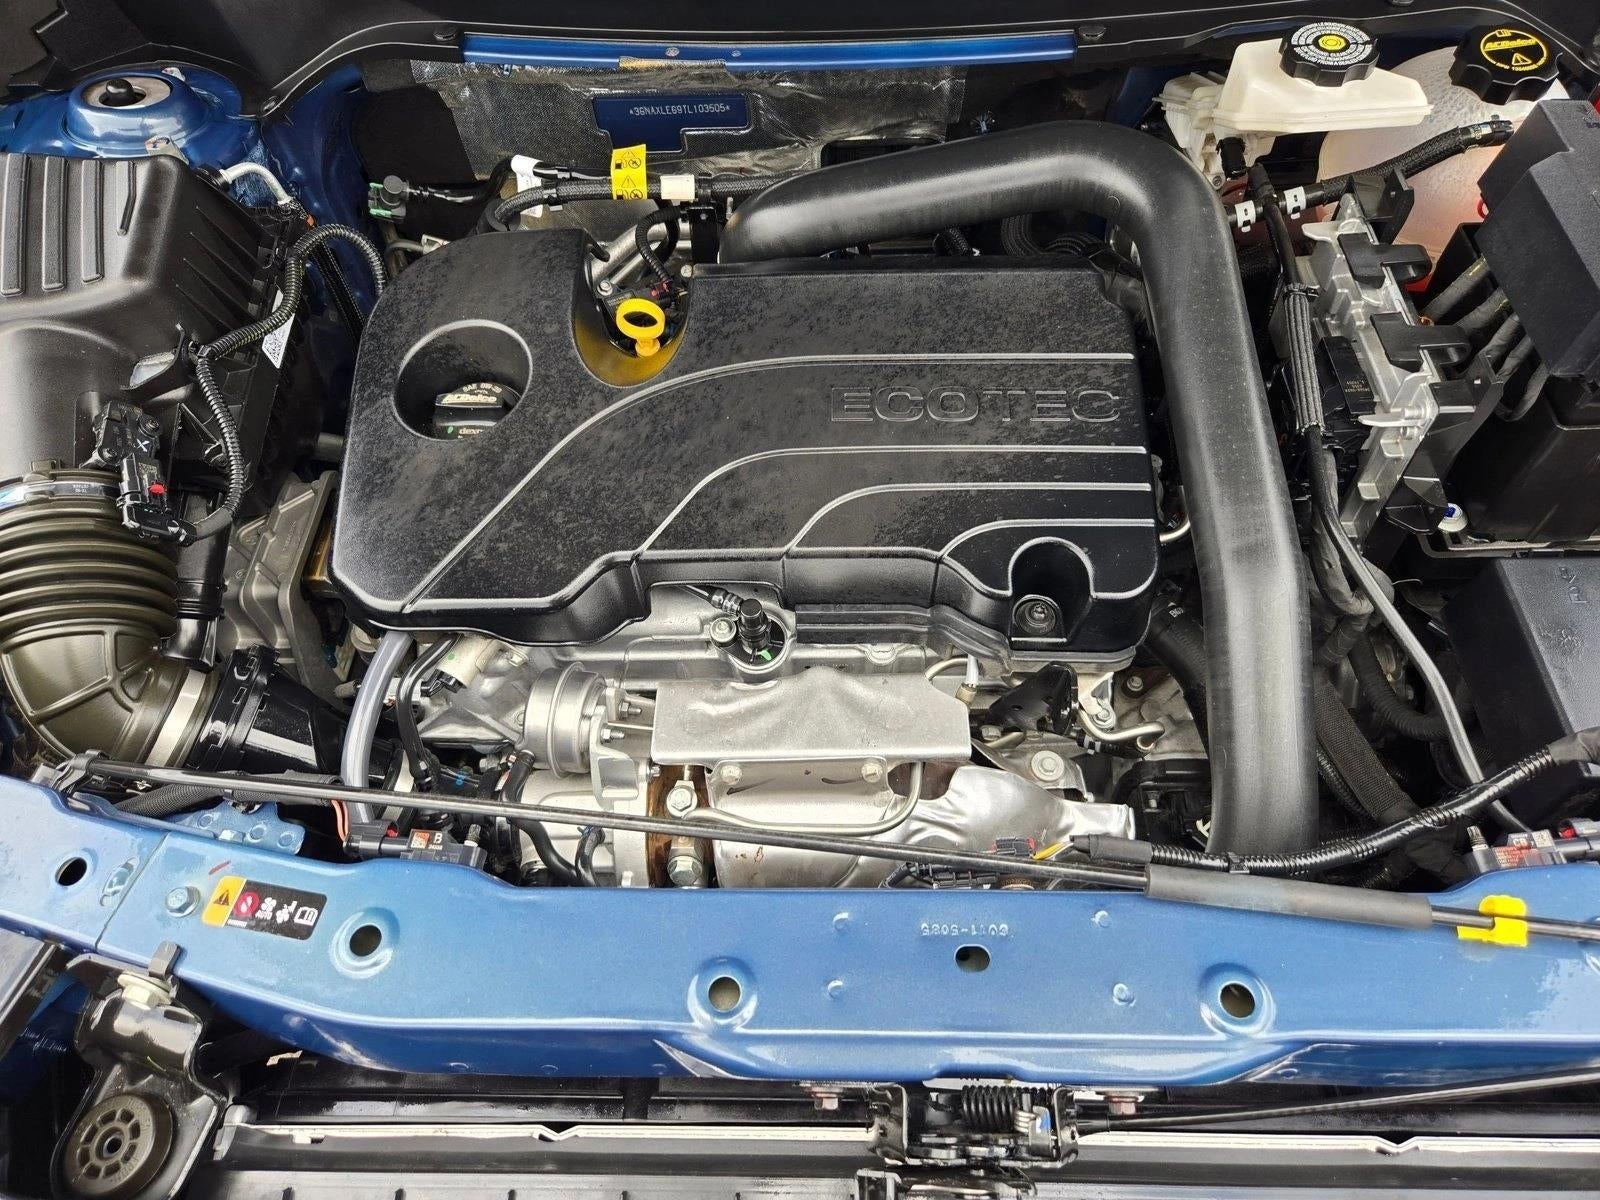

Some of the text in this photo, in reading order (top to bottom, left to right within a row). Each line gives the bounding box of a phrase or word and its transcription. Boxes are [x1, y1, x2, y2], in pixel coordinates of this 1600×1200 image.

[462, 383, 478, 393] SAE
[441, 393, 498, 405] ACDelco
[831, 386, 1121, 422] ECOTEC
[433, 832, 443, 844] B
[254, 909, 273, 921] AUTO
